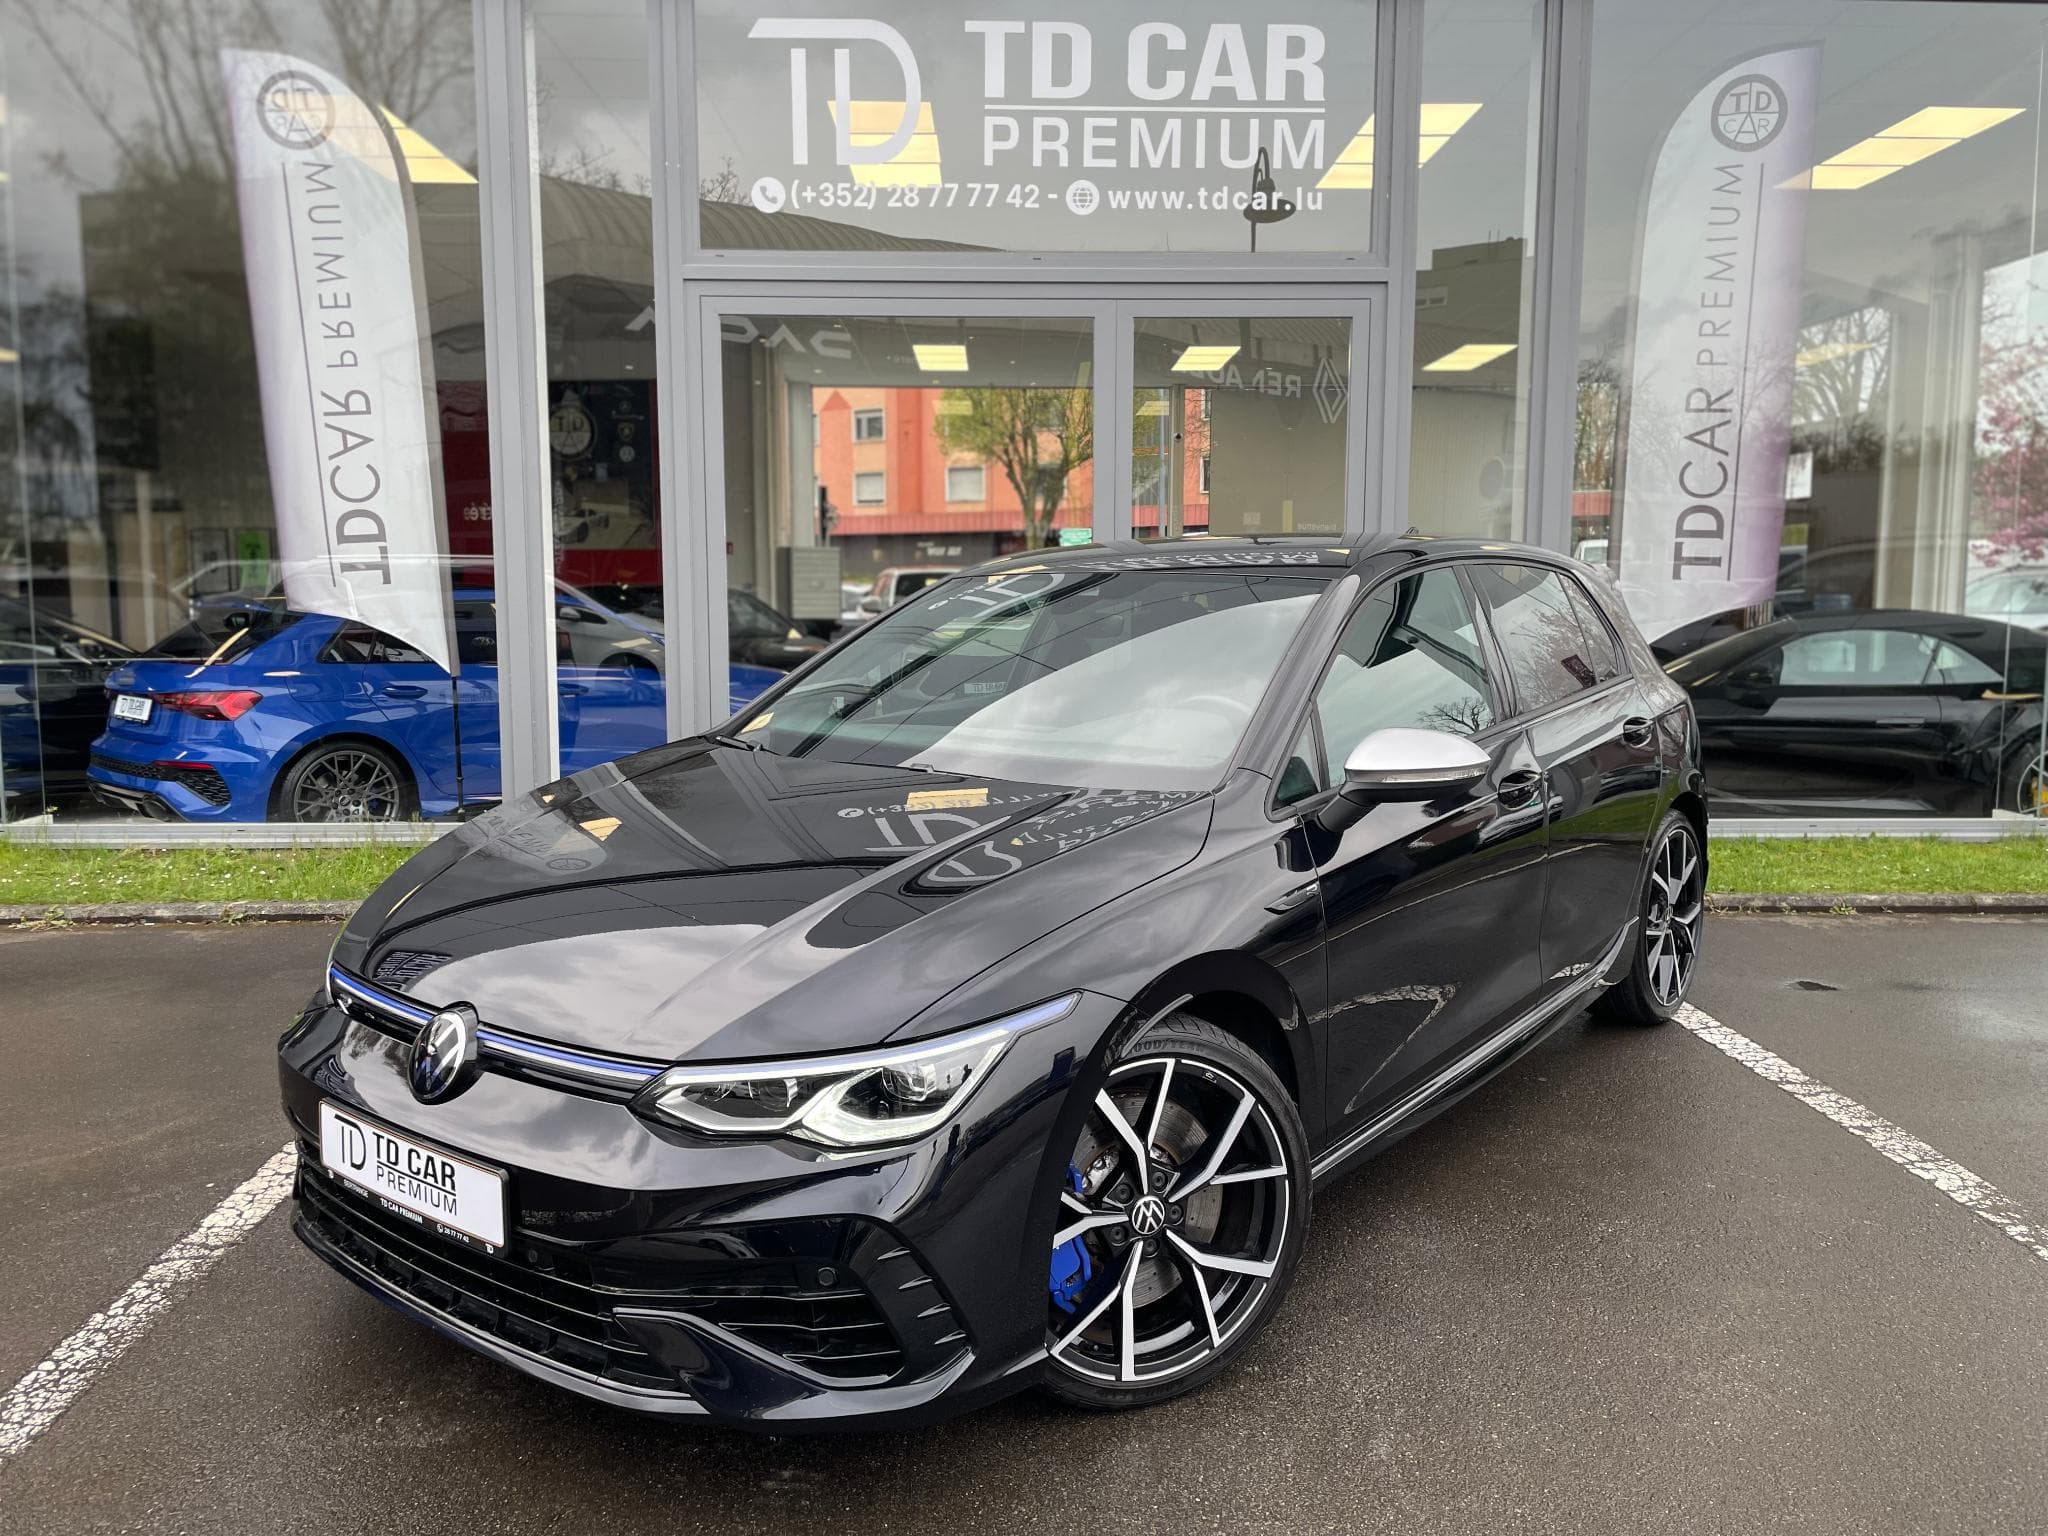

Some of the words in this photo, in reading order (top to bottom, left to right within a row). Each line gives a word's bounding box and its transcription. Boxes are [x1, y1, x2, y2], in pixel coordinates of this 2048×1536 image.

[964, 20, 1092, 99] TD
[1126, 22, 1326, 102] CAR
[983, 114, 1326, 169] PREMIUM
[790, 178, 878, 210] (+352)
[886, 182, 921, 208] 28
[927, 182, 960, 208] 77
[966, 182, 1000, 208] 77
[1005, 183, 1041, 209] 42
[1107, 186, 1324, 212] www.tdcar.lu
[1696, 163, 1745, 367] PREMIUM
[372, 1131, 399, 1167] TD
[407, 1148, 456, 1192] CAR
[376, 1165, 458, 1216] PREMIUM
